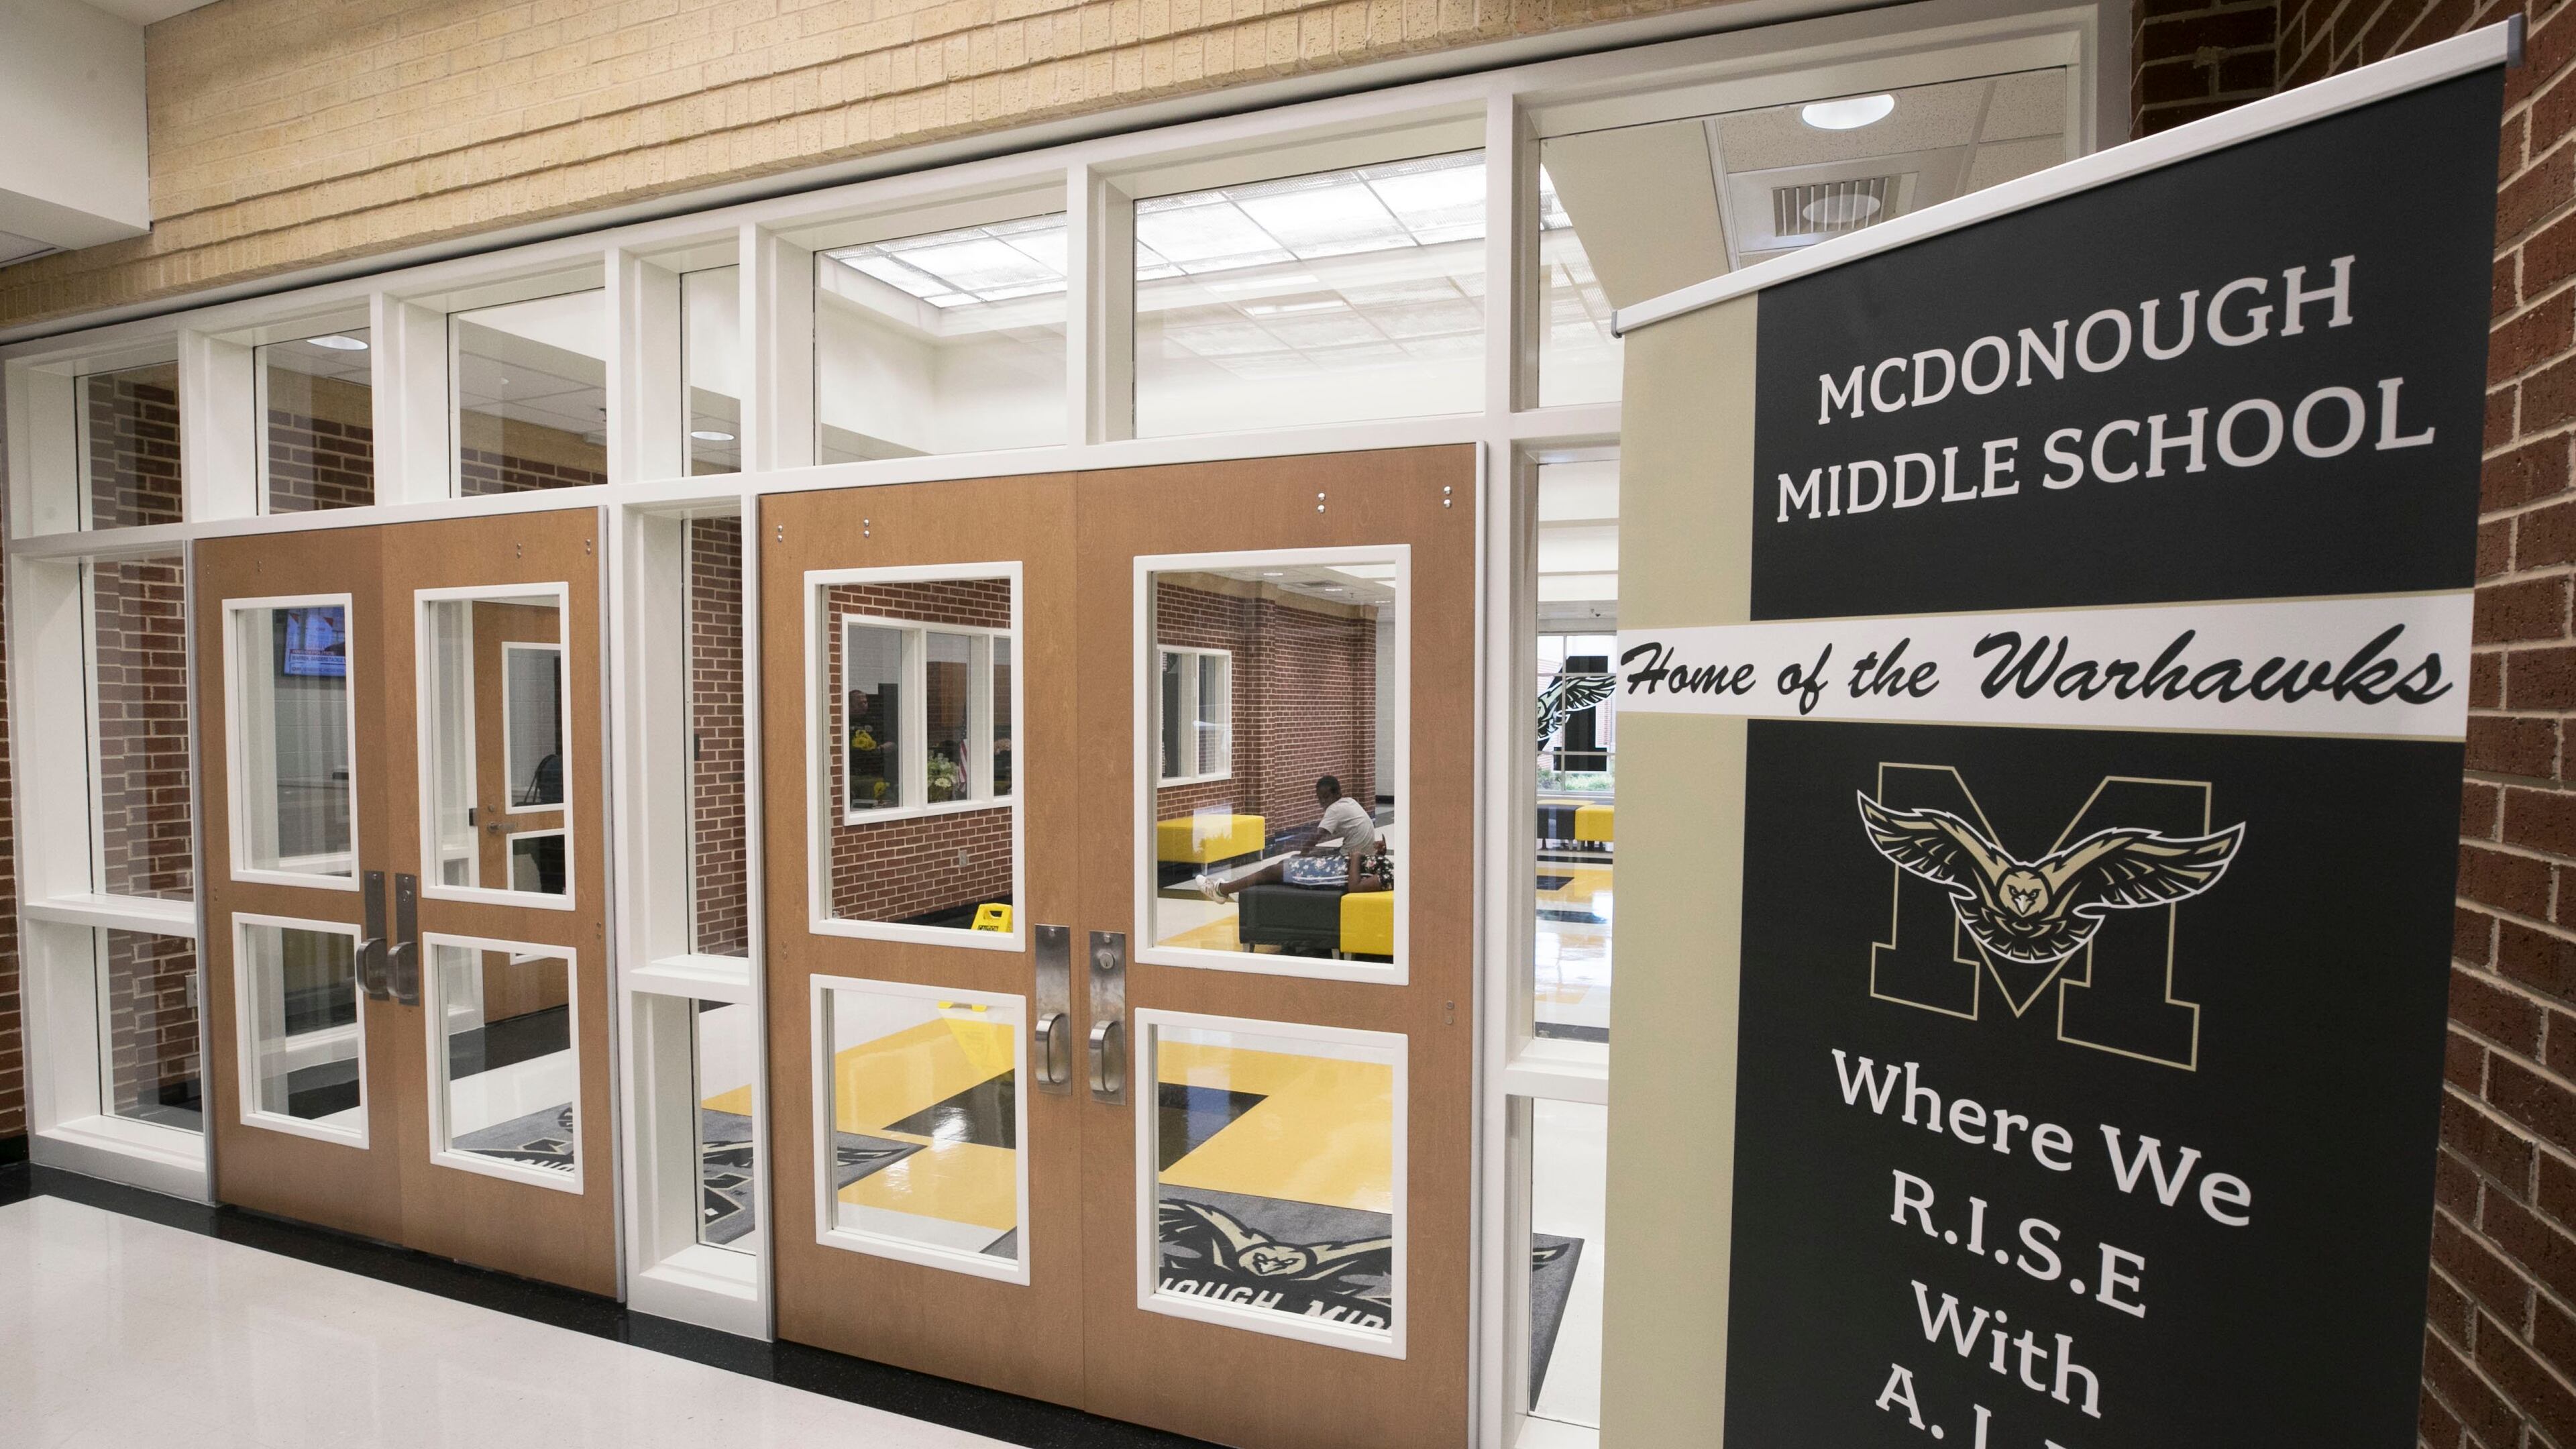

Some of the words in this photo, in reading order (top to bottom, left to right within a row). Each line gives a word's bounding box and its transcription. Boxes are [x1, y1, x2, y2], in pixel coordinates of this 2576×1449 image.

[1819, 256, 2355, 425] MCDONOUGH
[1777, 437, 2019, 523] MIDDLE
[2043, 378, 2434, 489] SCHOOL
[1621, 643, 1756, 695] Home
[1778, 643, 1832, 715] of
[1848, 638, 1939, 698] the
[1974, 624, 2453, 705] Warhawks
[1832, 1049, 2073, 1171] Where
[2100, 1124, 2251, 1226] We
[1891, 1169, 2145, 1318] R.I.S.E
[1911, 1280, 2101, 1418] With
